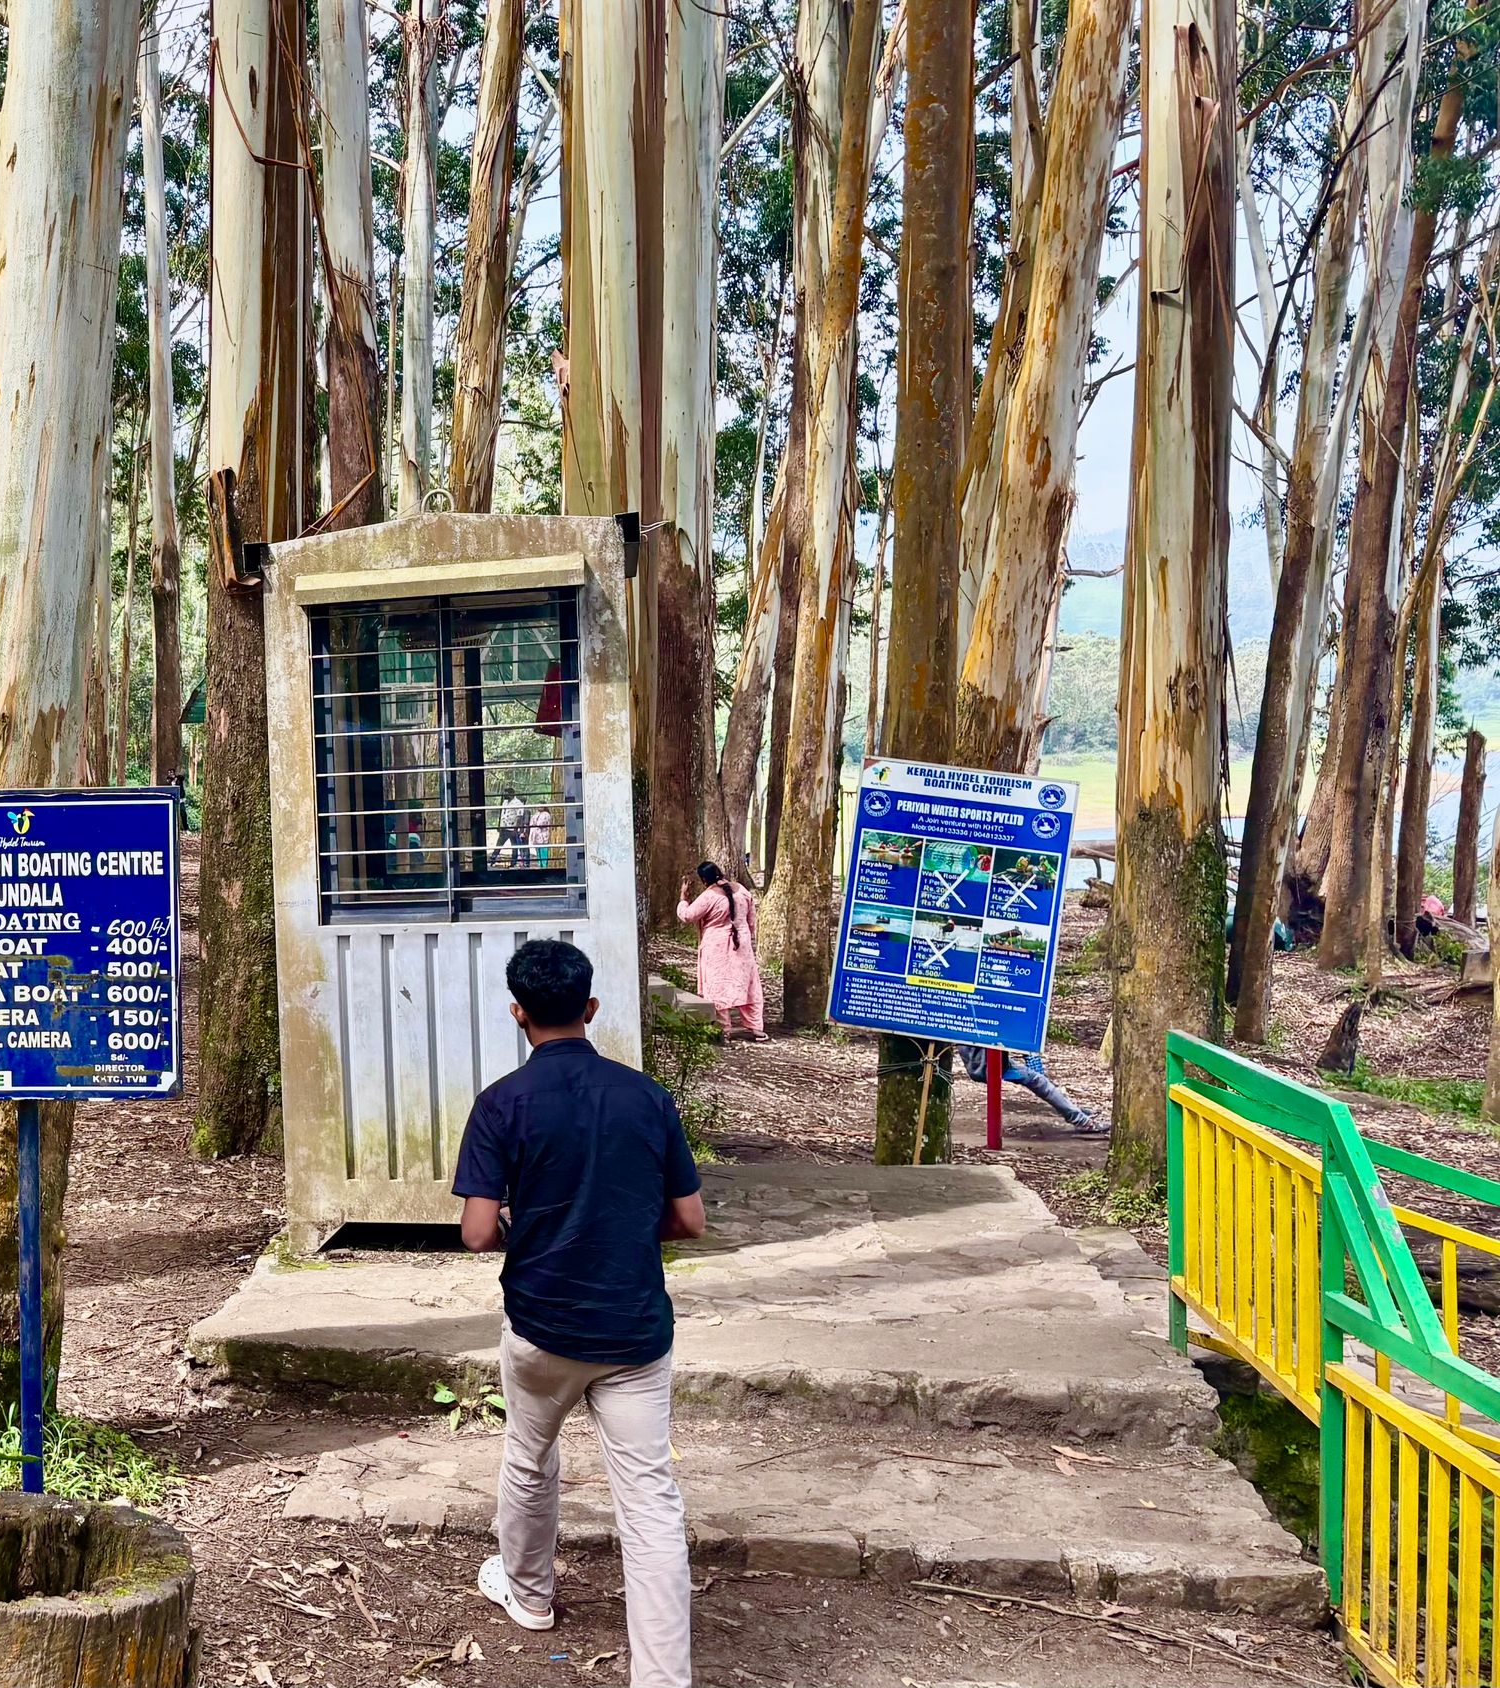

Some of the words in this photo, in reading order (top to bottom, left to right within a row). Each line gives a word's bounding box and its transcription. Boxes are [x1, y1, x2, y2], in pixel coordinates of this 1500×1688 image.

[906, 766, 945, 779] KERALA
[948, 771, 980, 784] HYDEL
[983, 775, 1032, 790] TOURISM
[924, 778, 969, 792] BOATING
[972, 783, 1012, 797] CENTRE
[896, 799, 931, 814] PERIYAR
[931, 803, 959, 818] WATER
[960, 807, 991, 822] SPORTS
[940, 819, 966, 828] venture
[967, 822, 982, 830] with
[20, 836, 46, 848] Tourism
[17, 852, 92, 876] BOATING
[96, 851, 164, 875] CENTRE
[861, 860, 893, 870] Kayaking
[865, 869, 888, 877] Person
[863, 885, 887, 894] Person
[106, 937, 168, 956] 400/-
[853, 955, 877, 964] Person
[987, 956, 1011, 965] Person
[106, 961, 168, 978] 500/-
[1014, 964, 1031, 976] 600
[852, 977, 873, 985] TICKETS
[985, 972, 1009, 981] Person
[14, 985, 83, 1003] BOAT
[106, 985, 168, 1003] 600/-
[879, 986, 898, 994] JACKET
[107, 1009, 169, 1027] 150/-
[7, 1031, 72, 1049] CAMERA
[107, 1032, 169, 1051] 600/-
[94, 1064, 146, 1072] DIRECTOR
[125, 1075, 147, 1083] TVM
